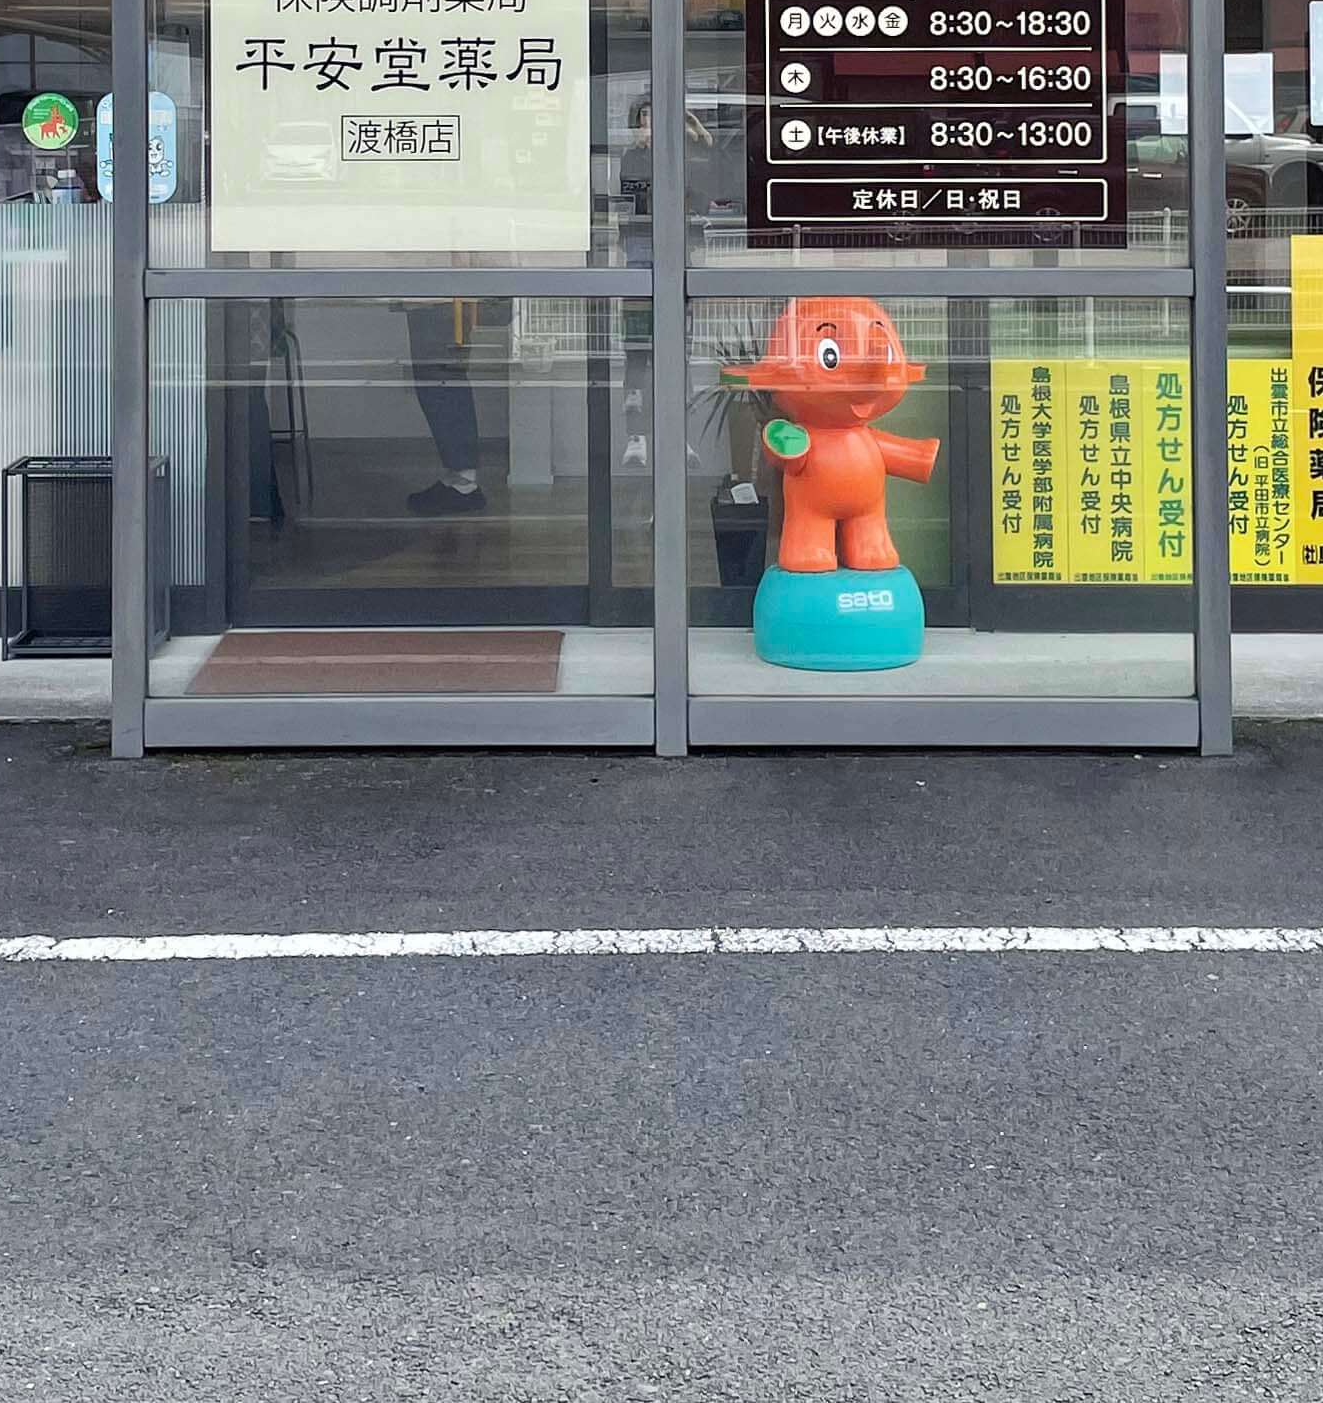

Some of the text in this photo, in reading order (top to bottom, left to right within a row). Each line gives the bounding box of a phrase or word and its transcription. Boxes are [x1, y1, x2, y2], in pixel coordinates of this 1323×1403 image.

[235, 37, 562, 92] 平安堂薬局
[347, 119, 453, 155] 渡橋店
[1000, 394, 1022, 534] 処方せん受付
[1031, 366, 1054, 568] 島根大学医学部附属病院
[1079, 395, 1101, 534] 処方せん受付
[1109, 374, 1133, 562] 島根県立中央病院
[1156, 372, 1185, 558] 処方せん受付
[1228, 395, 1249, 535] 処方せん受付
[1270, 367, 1290, 565] 出雲市立総合医療センター
